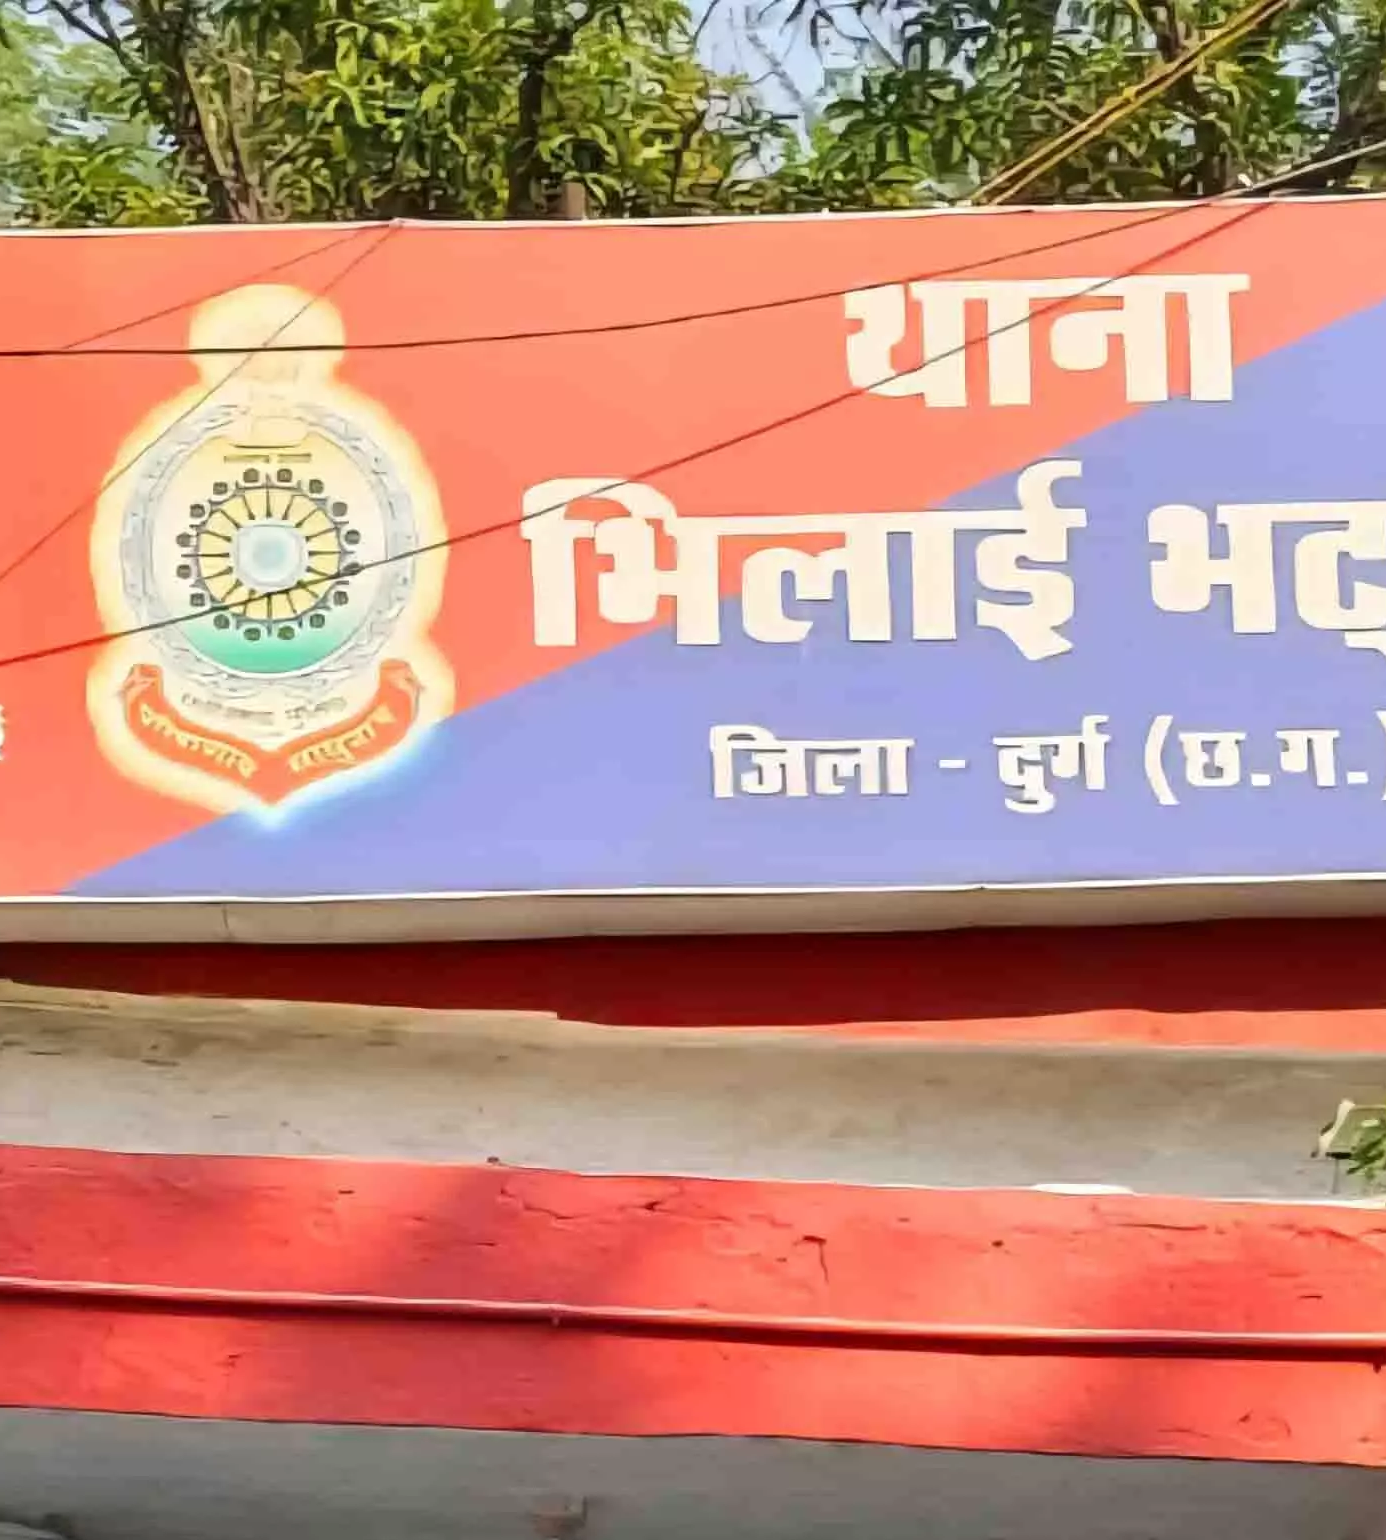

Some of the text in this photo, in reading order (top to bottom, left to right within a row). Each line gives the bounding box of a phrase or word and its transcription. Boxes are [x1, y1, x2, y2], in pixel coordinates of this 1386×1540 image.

[844, 272, 1249, 408] थाना
[520, 458, 1087, 661] भिलाई
[709, 722, 915, 799] जिला
[992, 713, 1111, 814] दुर्ग
